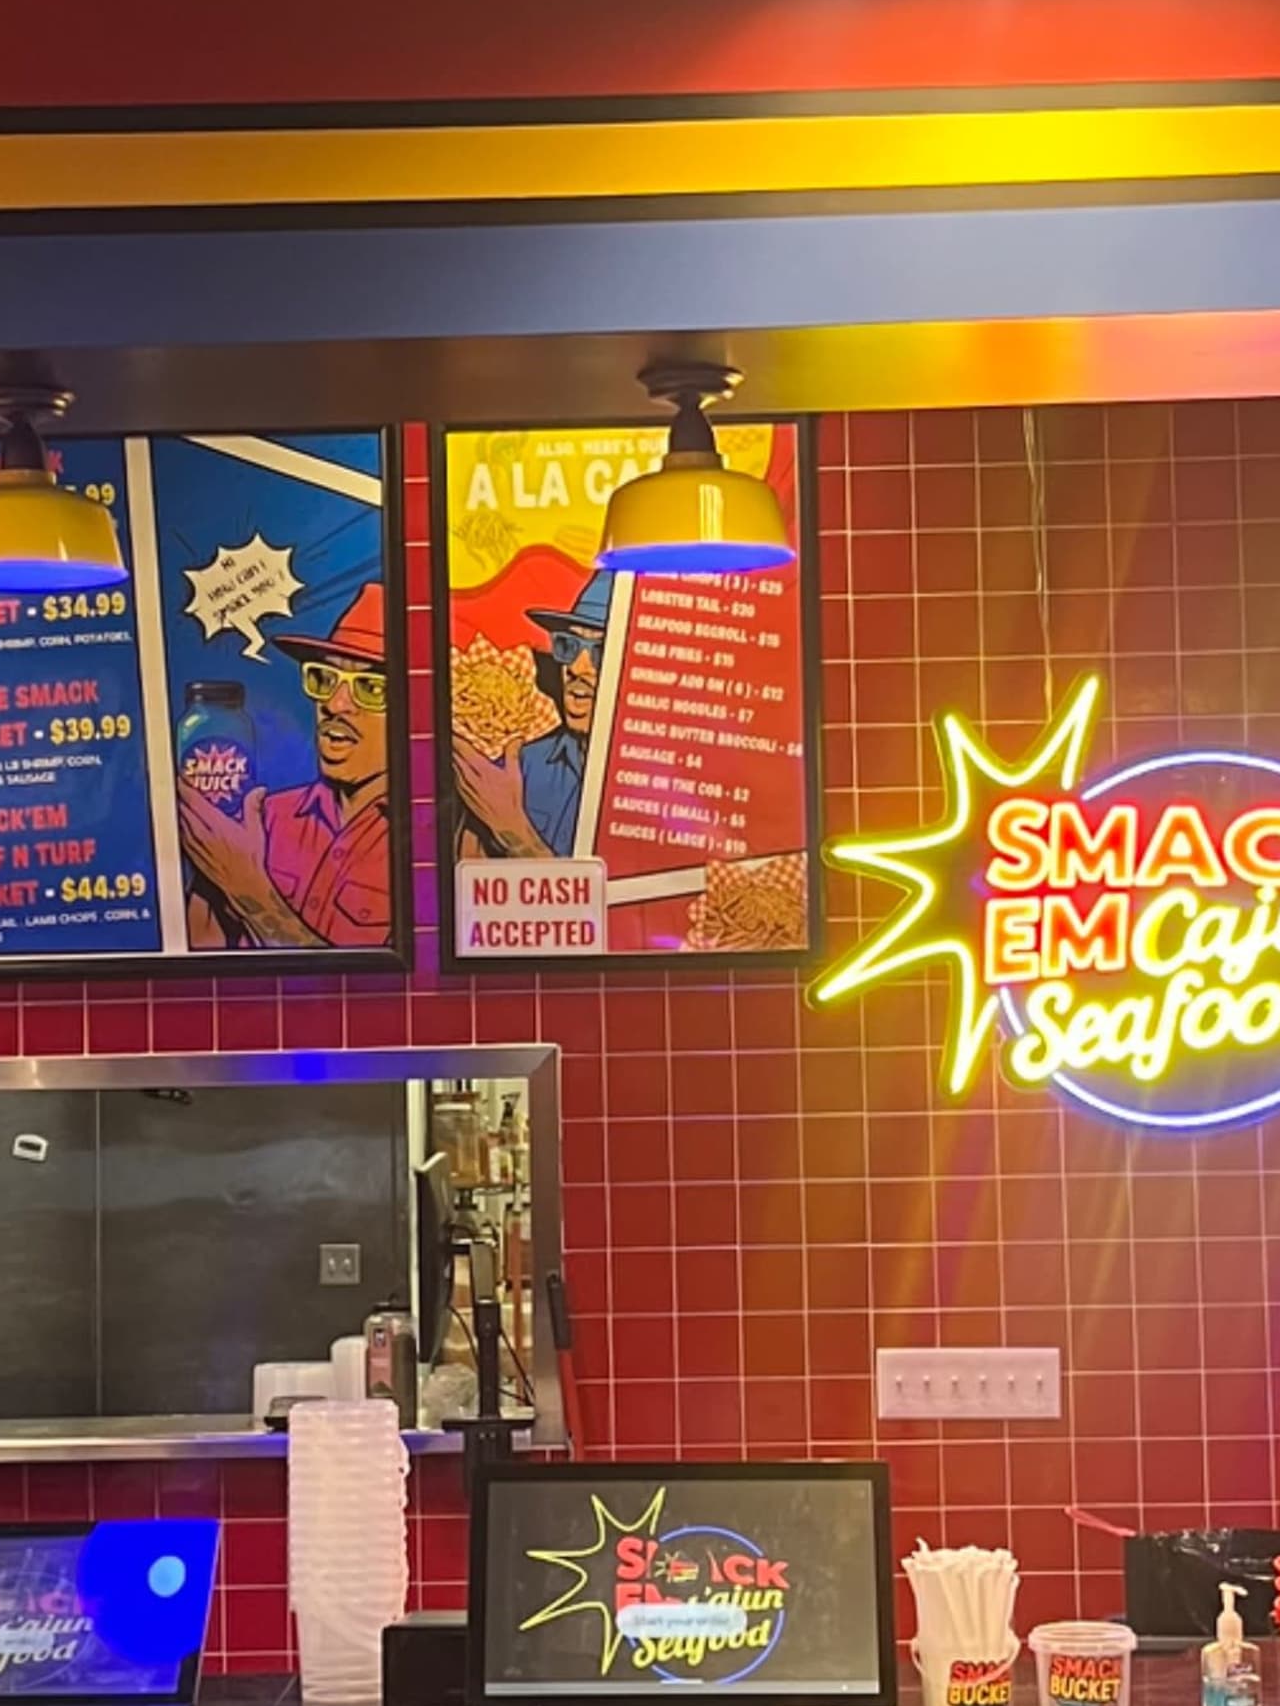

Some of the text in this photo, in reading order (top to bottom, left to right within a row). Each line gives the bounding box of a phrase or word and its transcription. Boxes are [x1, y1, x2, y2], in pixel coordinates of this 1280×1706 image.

[466, 463, 498, 511] A
[511, 461, 570, 508] LA
[43, 591, 127, 621] $34.99
[15, 680, 101, 709] SMACK
[50, 714, 131, 744] $39.99
[184, 756, 248, 776] SMACK
[12, 844, 30, 869] N
[35, 838, 96, 865] TURF
[61, 872, 147, 903] $44.99
[473, 877, 591, 906] NO CASH
[470, 919, 596, 948] ACCEPTED
[984, 893, 1129, 986] EM
[949, 1683, 1012, 1706] BUCKE
[1049, 1674, 1122, 1701] BUCKET
